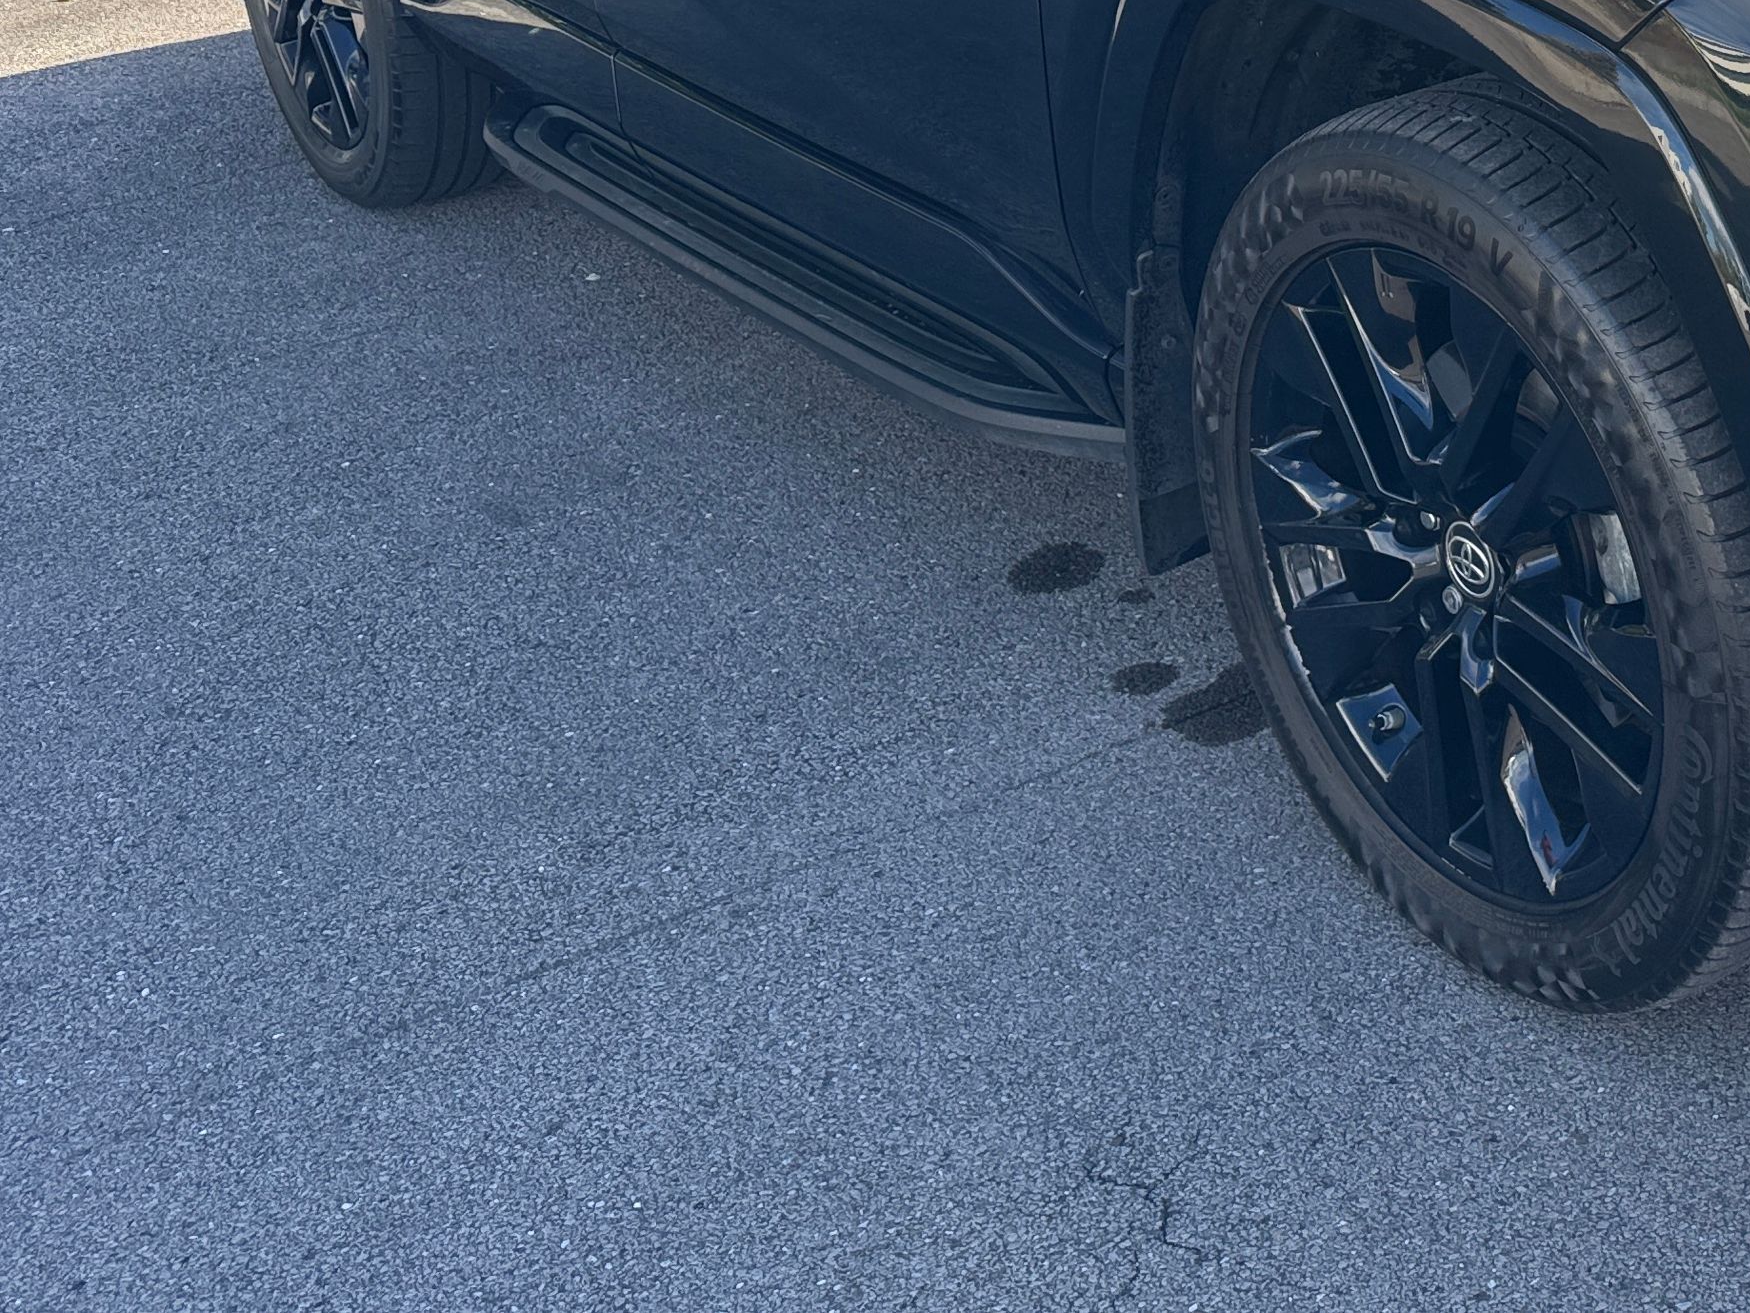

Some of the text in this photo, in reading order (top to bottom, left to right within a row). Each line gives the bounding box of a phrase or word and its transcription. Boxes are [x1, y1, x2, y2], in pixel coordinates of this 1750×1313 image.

[1319, 168, 1410, 215] 225/55
[1488, 236, 1514, 277] V
[1610, 722, 1714, 966] Continental
